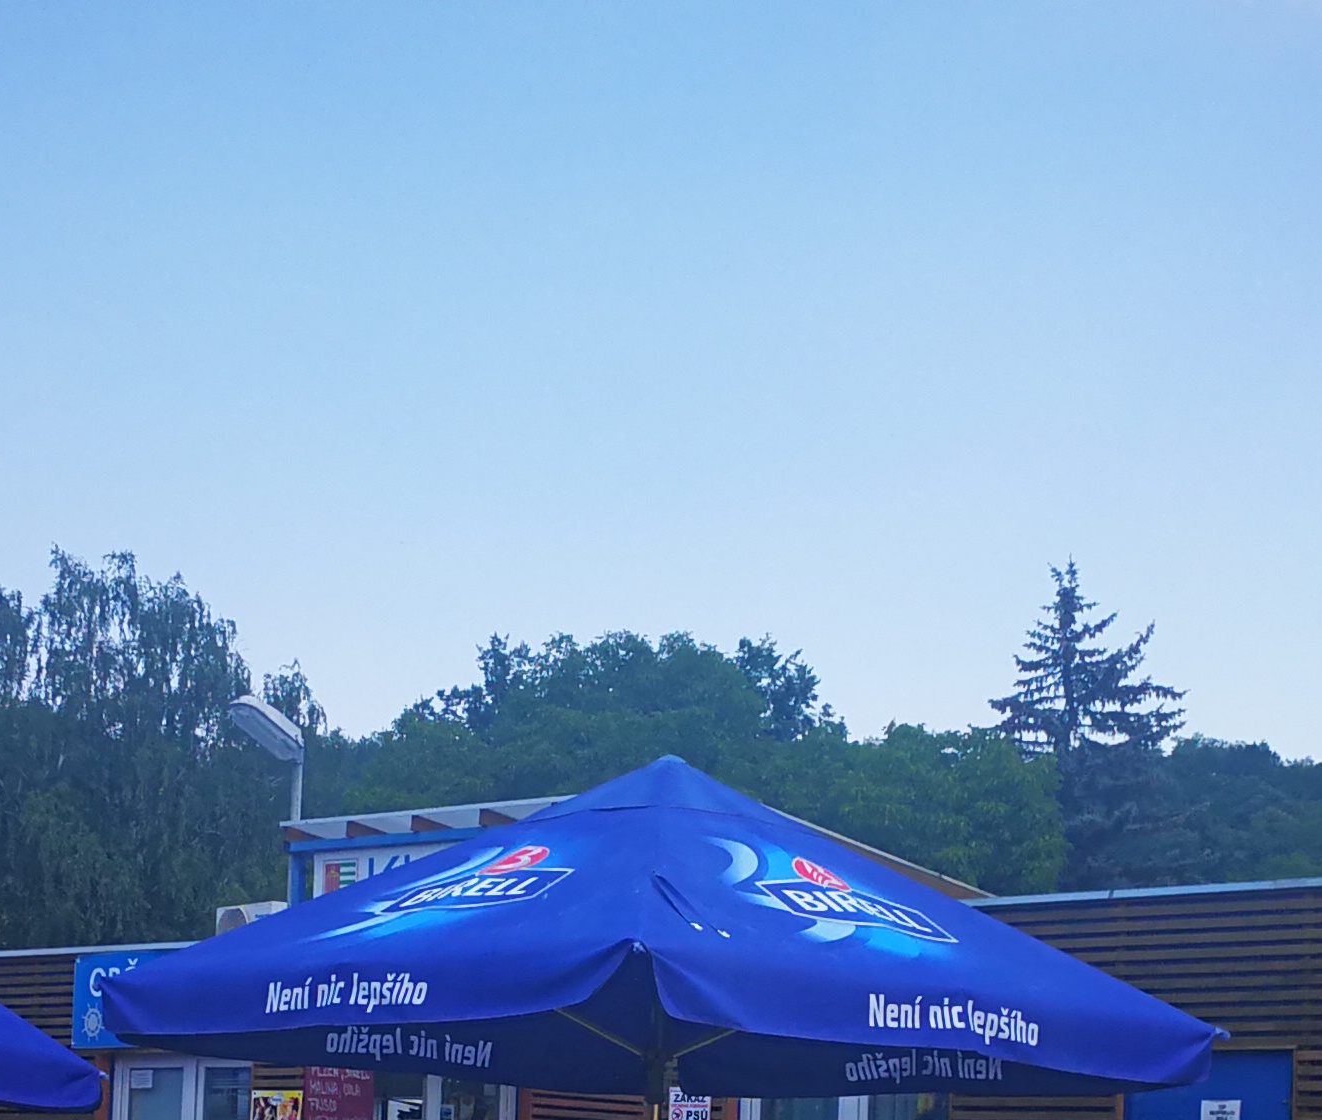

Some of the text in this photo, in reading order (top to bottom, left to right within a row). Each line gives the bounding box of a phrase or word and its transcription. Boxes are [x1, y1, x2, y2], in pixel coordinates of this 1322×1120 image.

[399, 877, 539, 908] BIRELL
[789, 889, 934, 934] BIRELL
[264, 971, 429, 1015] Není nic lepšího
[867, 992, 1041, 1048] Není nic lepšího
[686, 1108, 708, 1120] PSŮ
